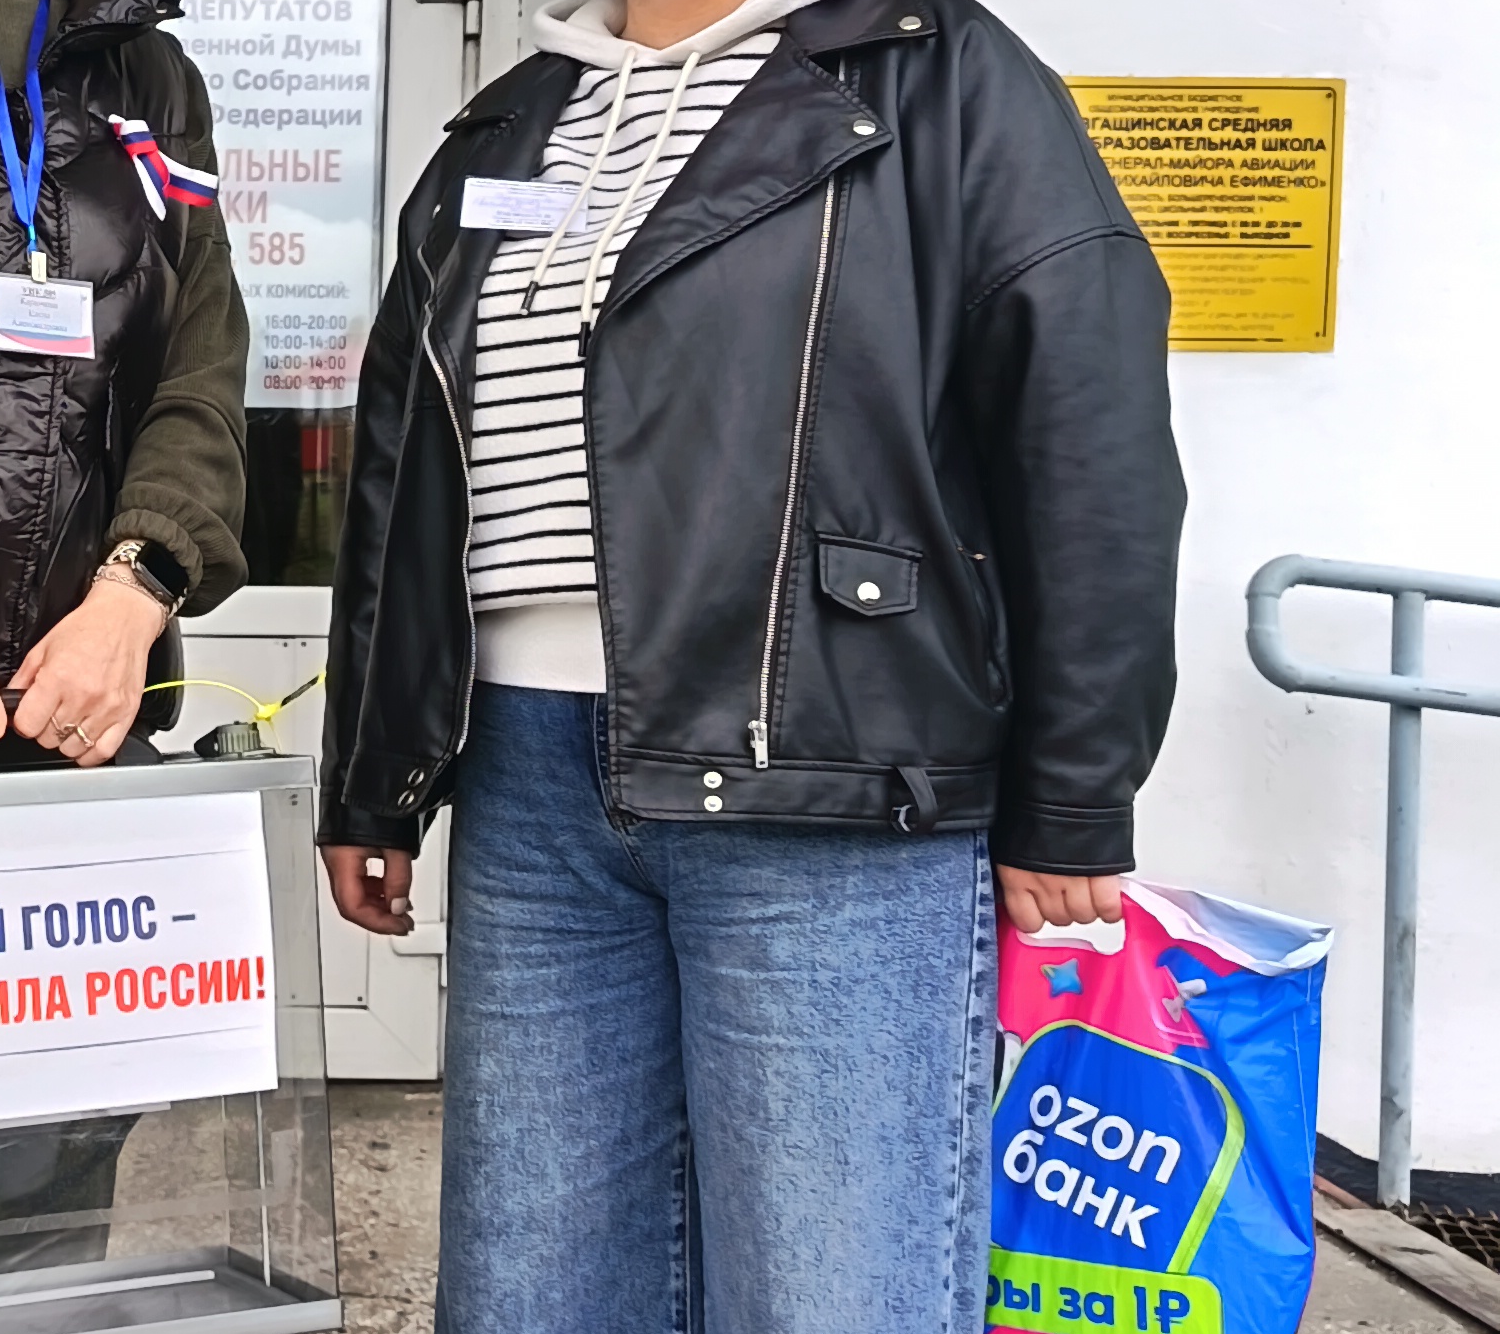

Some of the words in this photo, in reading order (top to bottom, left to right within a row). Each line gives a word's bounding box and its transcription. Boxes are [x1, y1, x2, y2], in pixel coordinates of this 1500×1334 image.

[184, 33, 275, 56] енной
[282, 34, 362, 62] Думы
[233, 68, 370, 96] Собрания
[1208, 117, 1293, 134] СРЕДНЯЯ
[1093, 137, 1256, 152] БРАЗОВАТЕЛЬНАЯ
[1261, 138, 1327, 152] ШКОЛА
[1103, 154, 1235, 170] ЕНЕРАЛ-МАЙОРА
[1240, 157, 1316, 171] АВИАЦИИ
[1230, 175, 1327, 189] ЕФИМЕНКО»
[248, 232, 306, 266] 585
[264, 335, 347, 351] 10:00-14:00
[264, 355, 347, 370] 10:00-14:00
[21, 894, 158, 952] ГОЛОС
[84, 956, 266, 1017] РОССИИ!
[1029, 1084, 1182, 1185] ozon
[1002, 1129, 1161, 1250] банк
[1058, 1286, 1115, 1326] за
